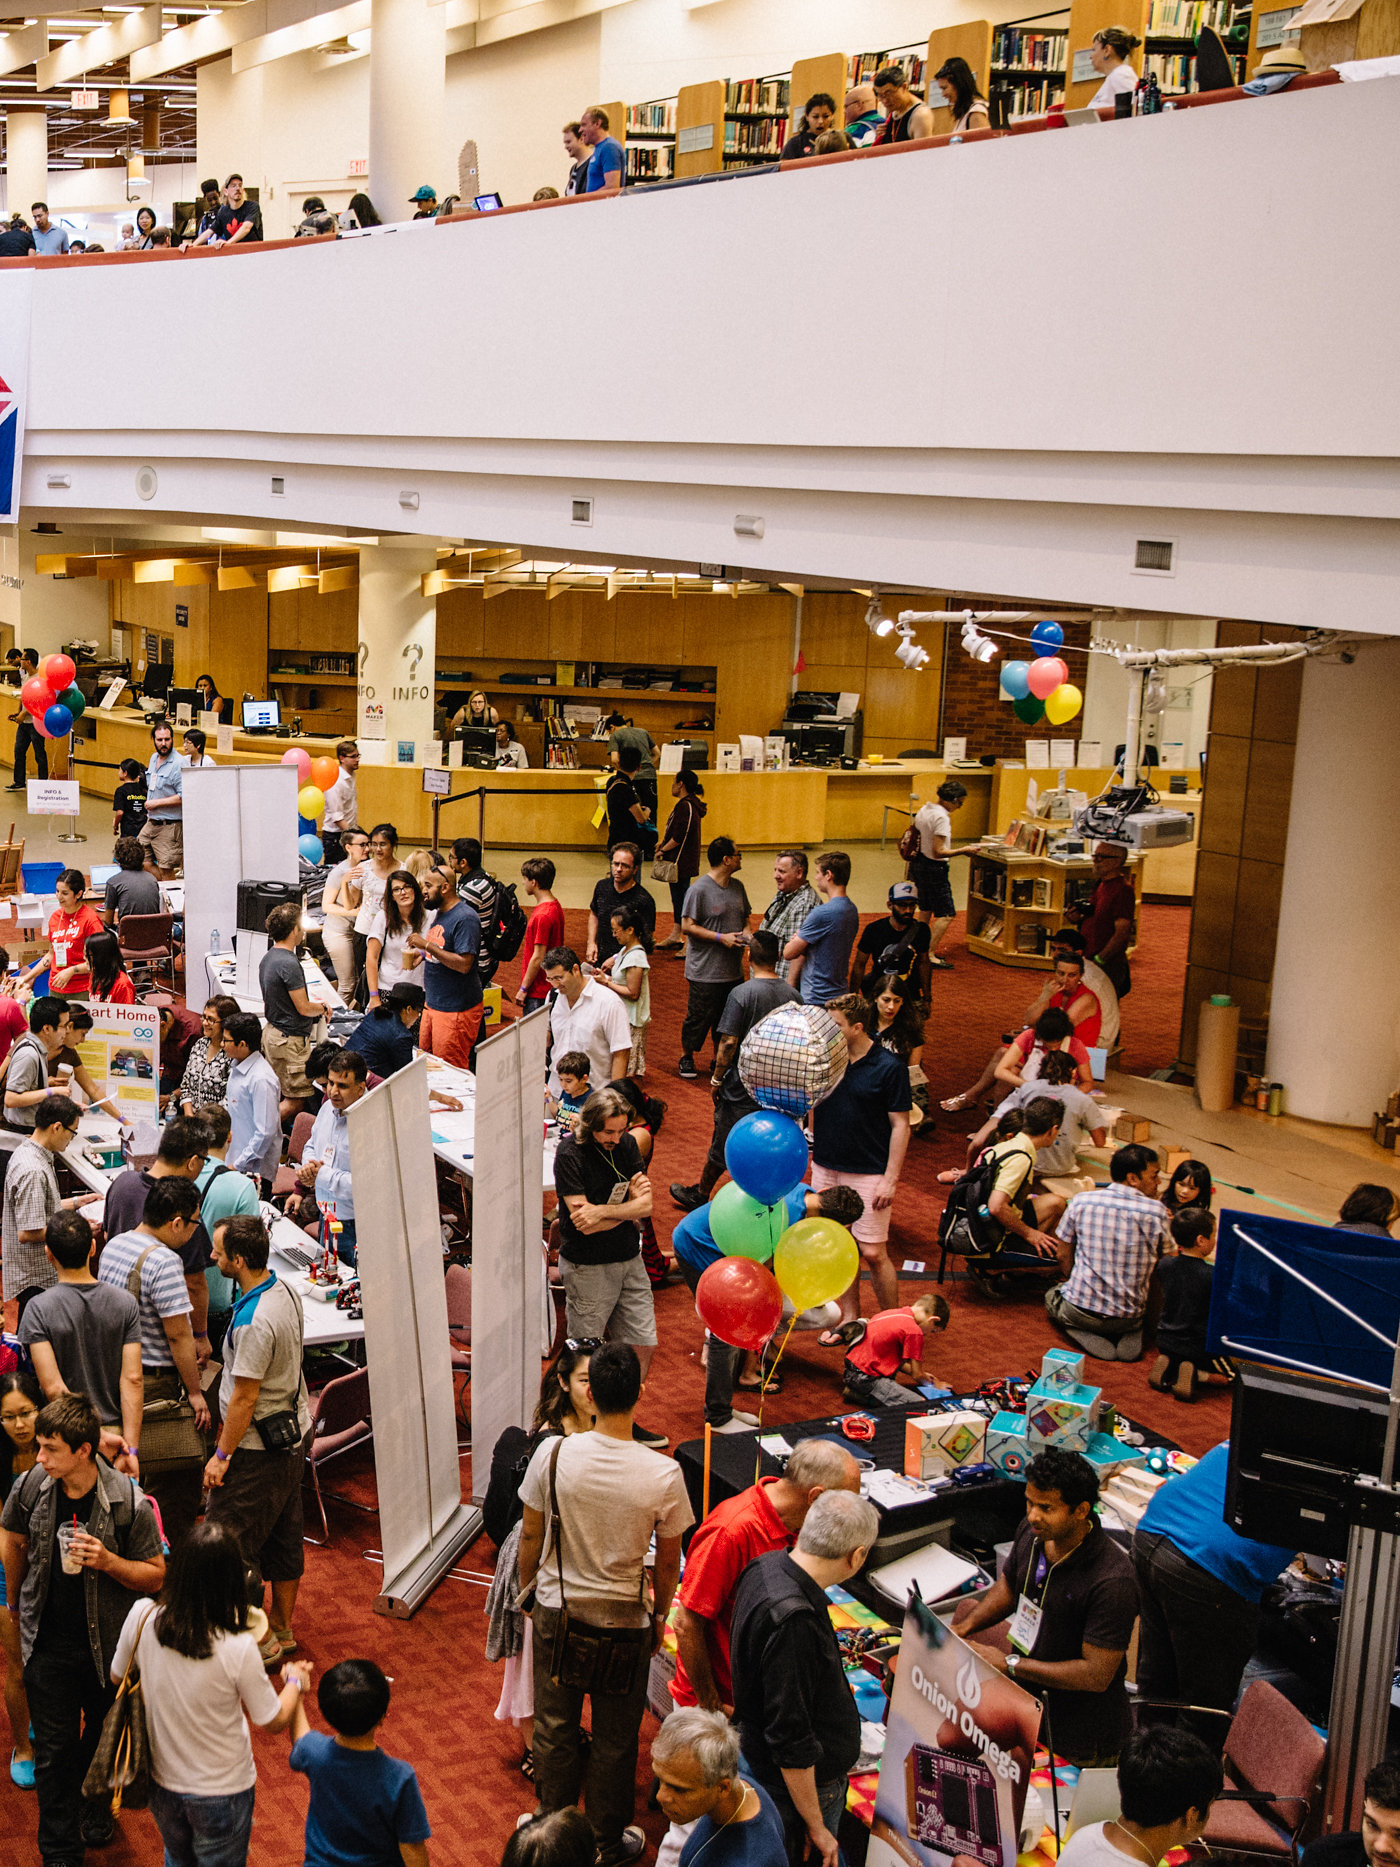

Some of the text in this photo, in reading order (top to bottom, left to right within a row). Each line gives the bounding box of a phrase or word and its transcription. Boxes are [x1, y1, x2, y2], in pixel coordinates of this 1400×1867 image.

[77, 93, 94, 106] EXIT
[350, 160, 366, 174] EXIT
[358, 684, 376, 700] NFO
[392, 685, 429, 700] INFO
[66, 926, 80, 938] my
[116, 1008, 156, 1023] Home
[911, 1664, 1021, 1785] Onion Omega
